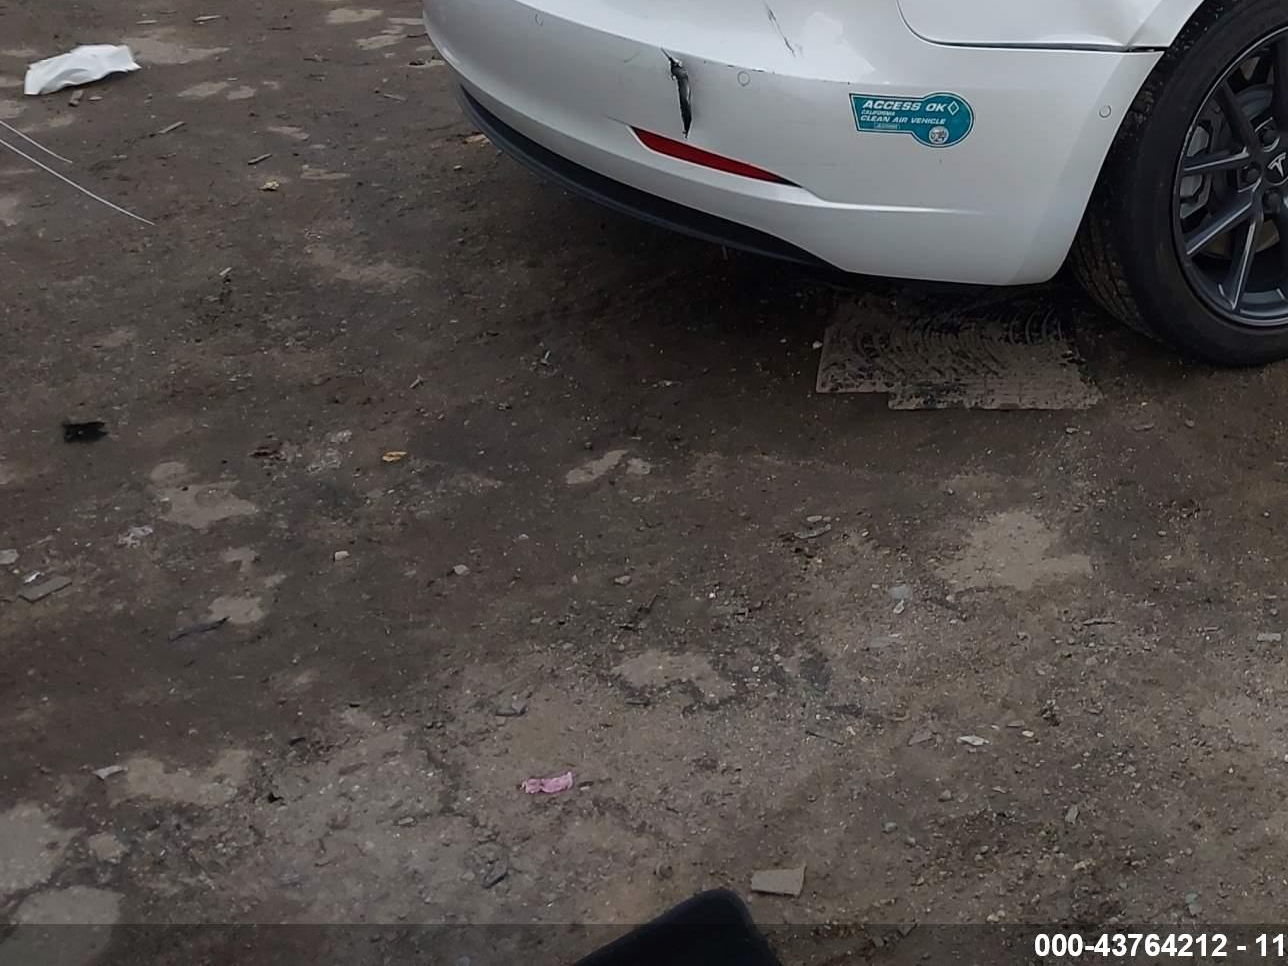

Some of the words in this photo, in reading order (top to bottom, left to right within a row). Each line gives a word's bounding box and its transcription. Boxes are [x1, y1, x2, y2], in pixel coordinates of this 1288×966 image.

[862, 100, 922, 112] ACCESS
[925, 102, 948, 113] OK
[860, 114, 891, 123] CLEAN
[892, 116, 909, 124] AIR
[910, 117, 947, 125] VEHICLE
